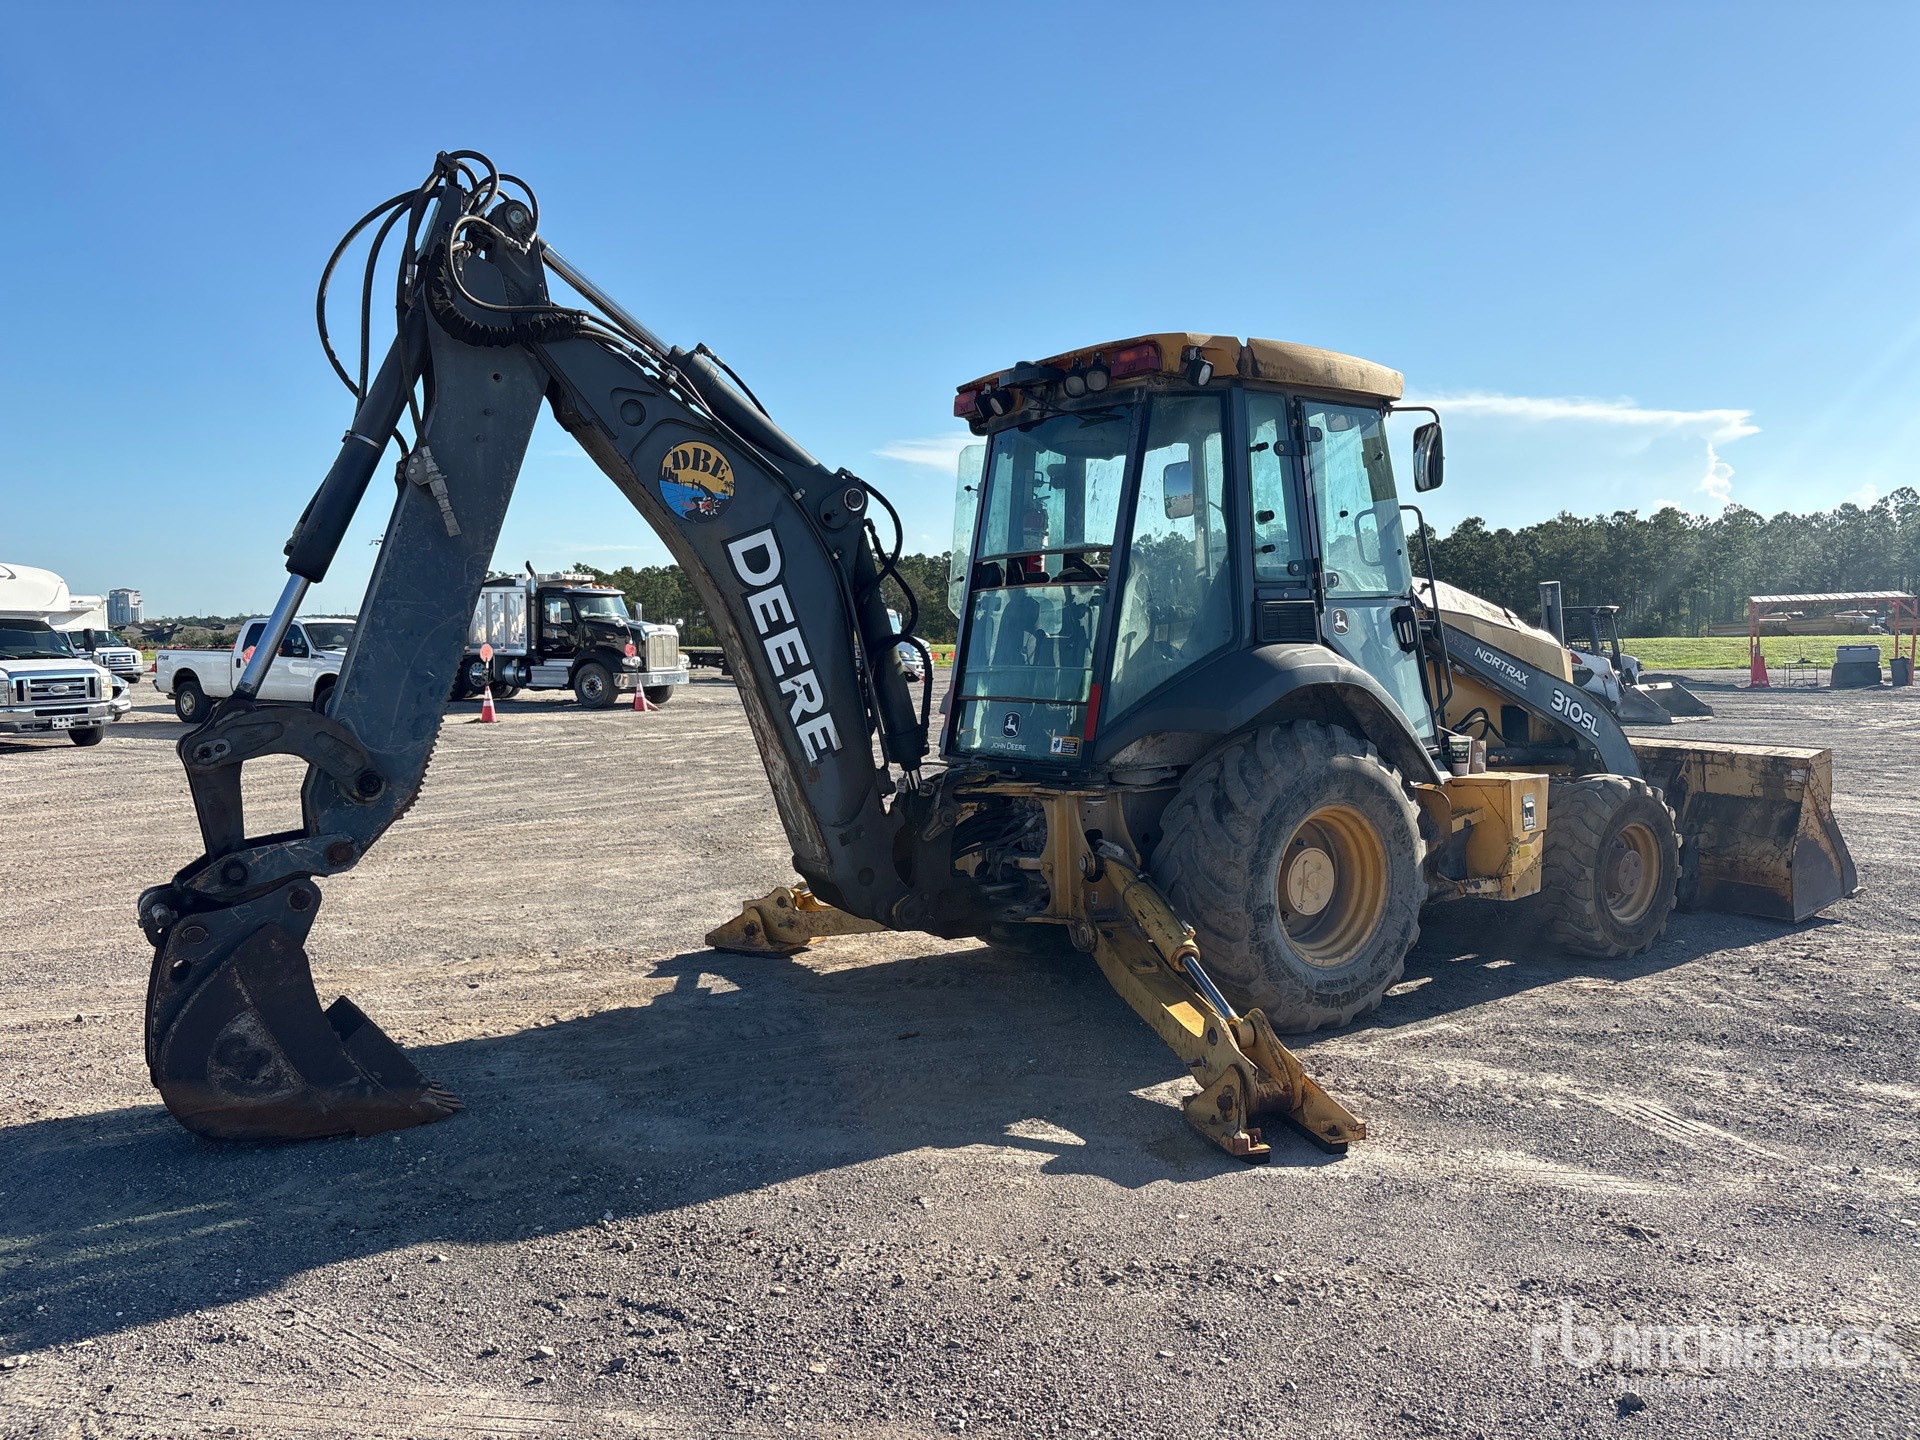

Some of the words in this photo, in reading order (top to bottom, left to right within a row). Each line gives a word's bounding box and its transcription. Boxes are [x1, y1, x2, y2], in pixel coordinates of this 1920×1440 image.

[670, 447, 730, 482] DBE
[727, 528, 842, 763] DEERE
[1474, 646, 1530, 685] NORTRAX
[1550, 688, 1600, 738] 310SL
[990, 741, 1006, 750] JOHN
[1006, 741, 1027, 752] DEERE
